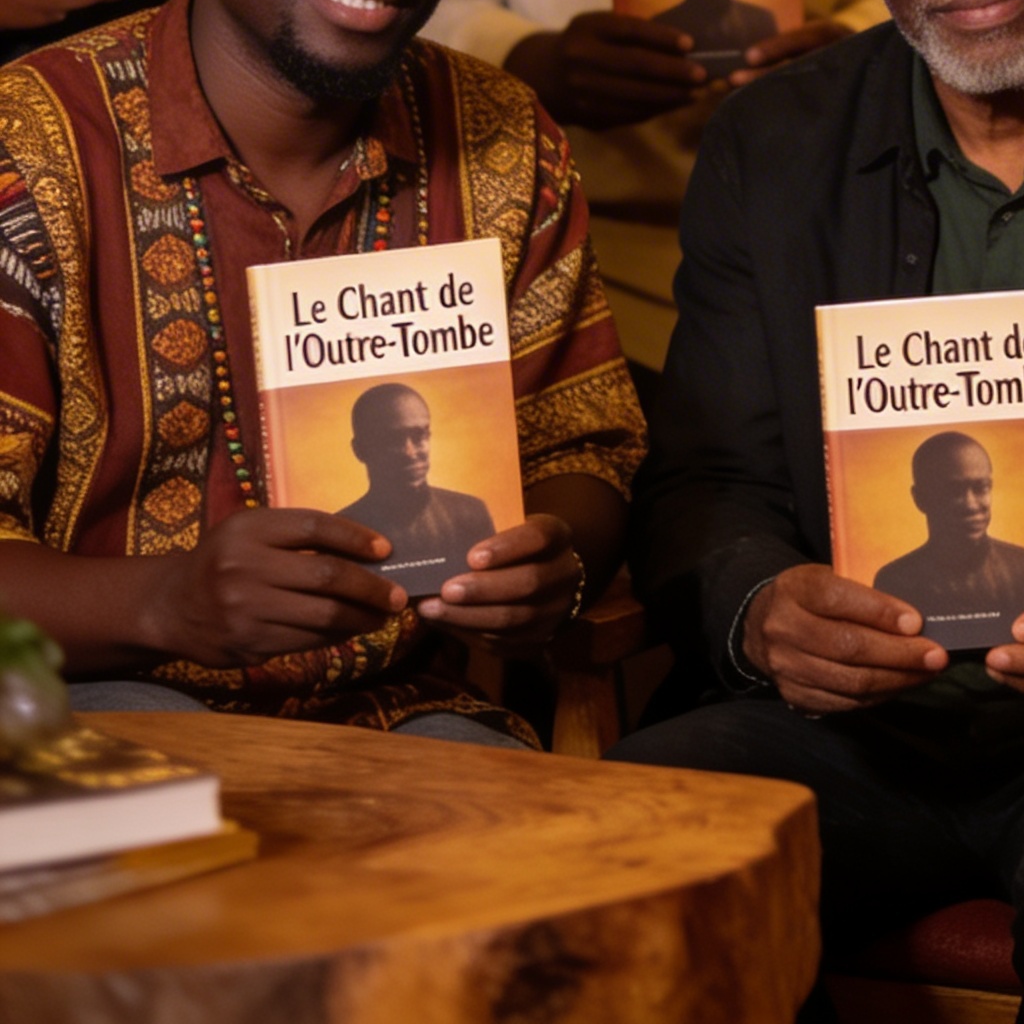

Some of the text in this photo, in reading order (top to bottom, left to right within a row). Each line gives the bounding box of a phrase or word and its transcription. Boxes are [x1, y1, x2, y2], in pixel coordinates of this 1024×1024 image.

[292, 272, 474, 327] Le Chant de
[285, 315, 494, 372] l'Outre-Tombe
[856, 335, 891, 370] Le
[902, 330, 993, 366] Chant
